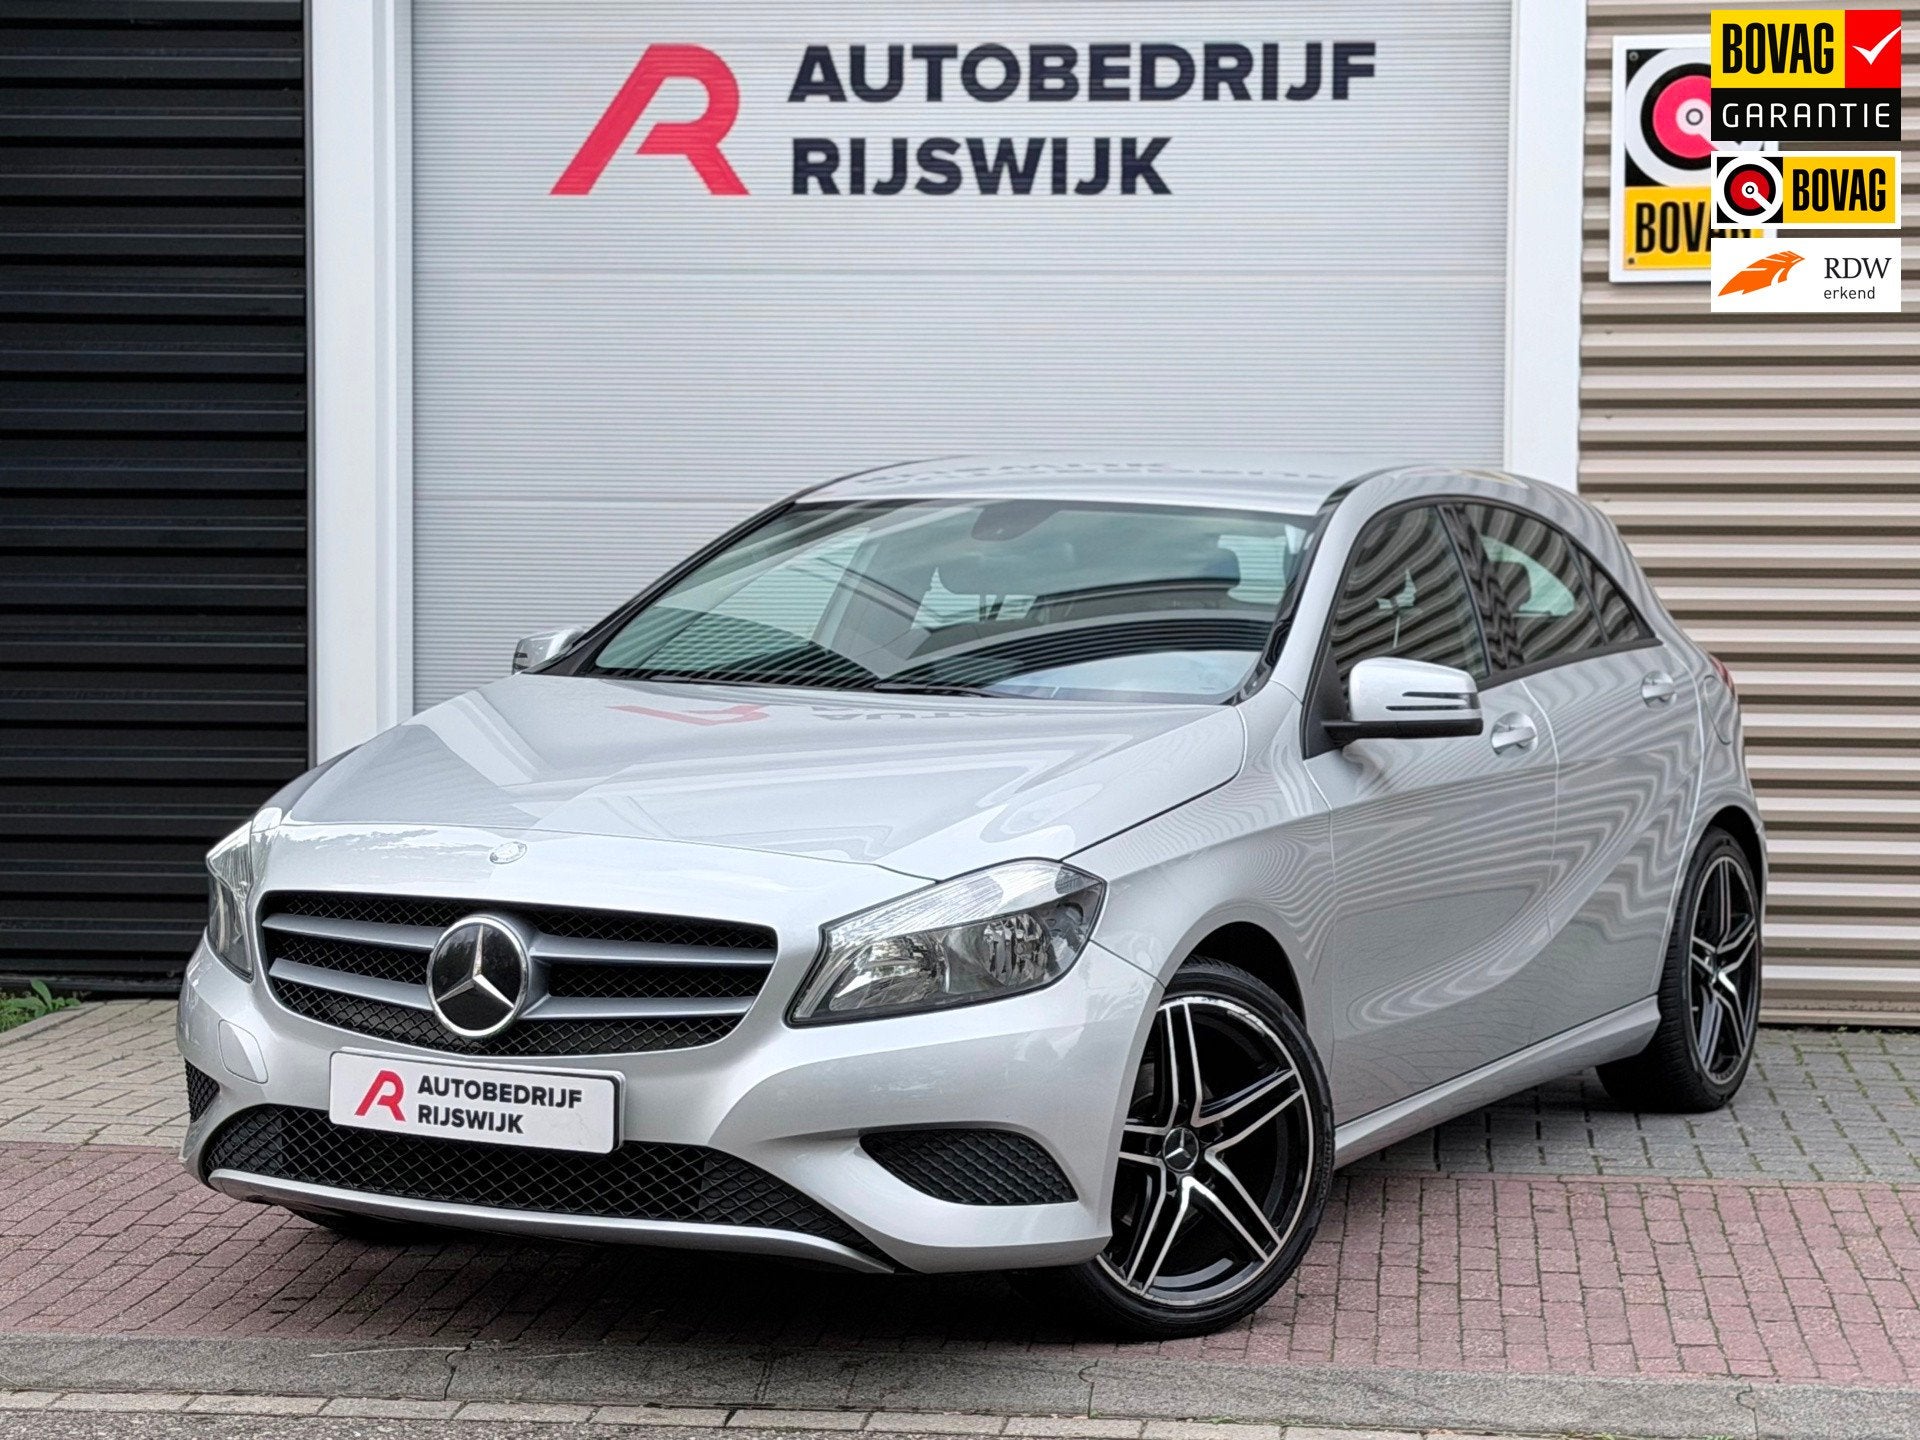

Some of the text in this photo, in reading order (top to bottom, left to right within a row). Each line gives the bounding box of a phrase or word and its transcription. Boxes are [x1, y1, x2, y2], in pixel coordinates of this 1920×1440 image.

[788, 42, 1377, 104] AUTOBEDRIJF
[793, 137, 1173, 196] RIJSWIJK
[417, 1075, 582, 1109] AUTOBEDRIJF
[417, 1104, 524, 1134] RIJSWIJK
